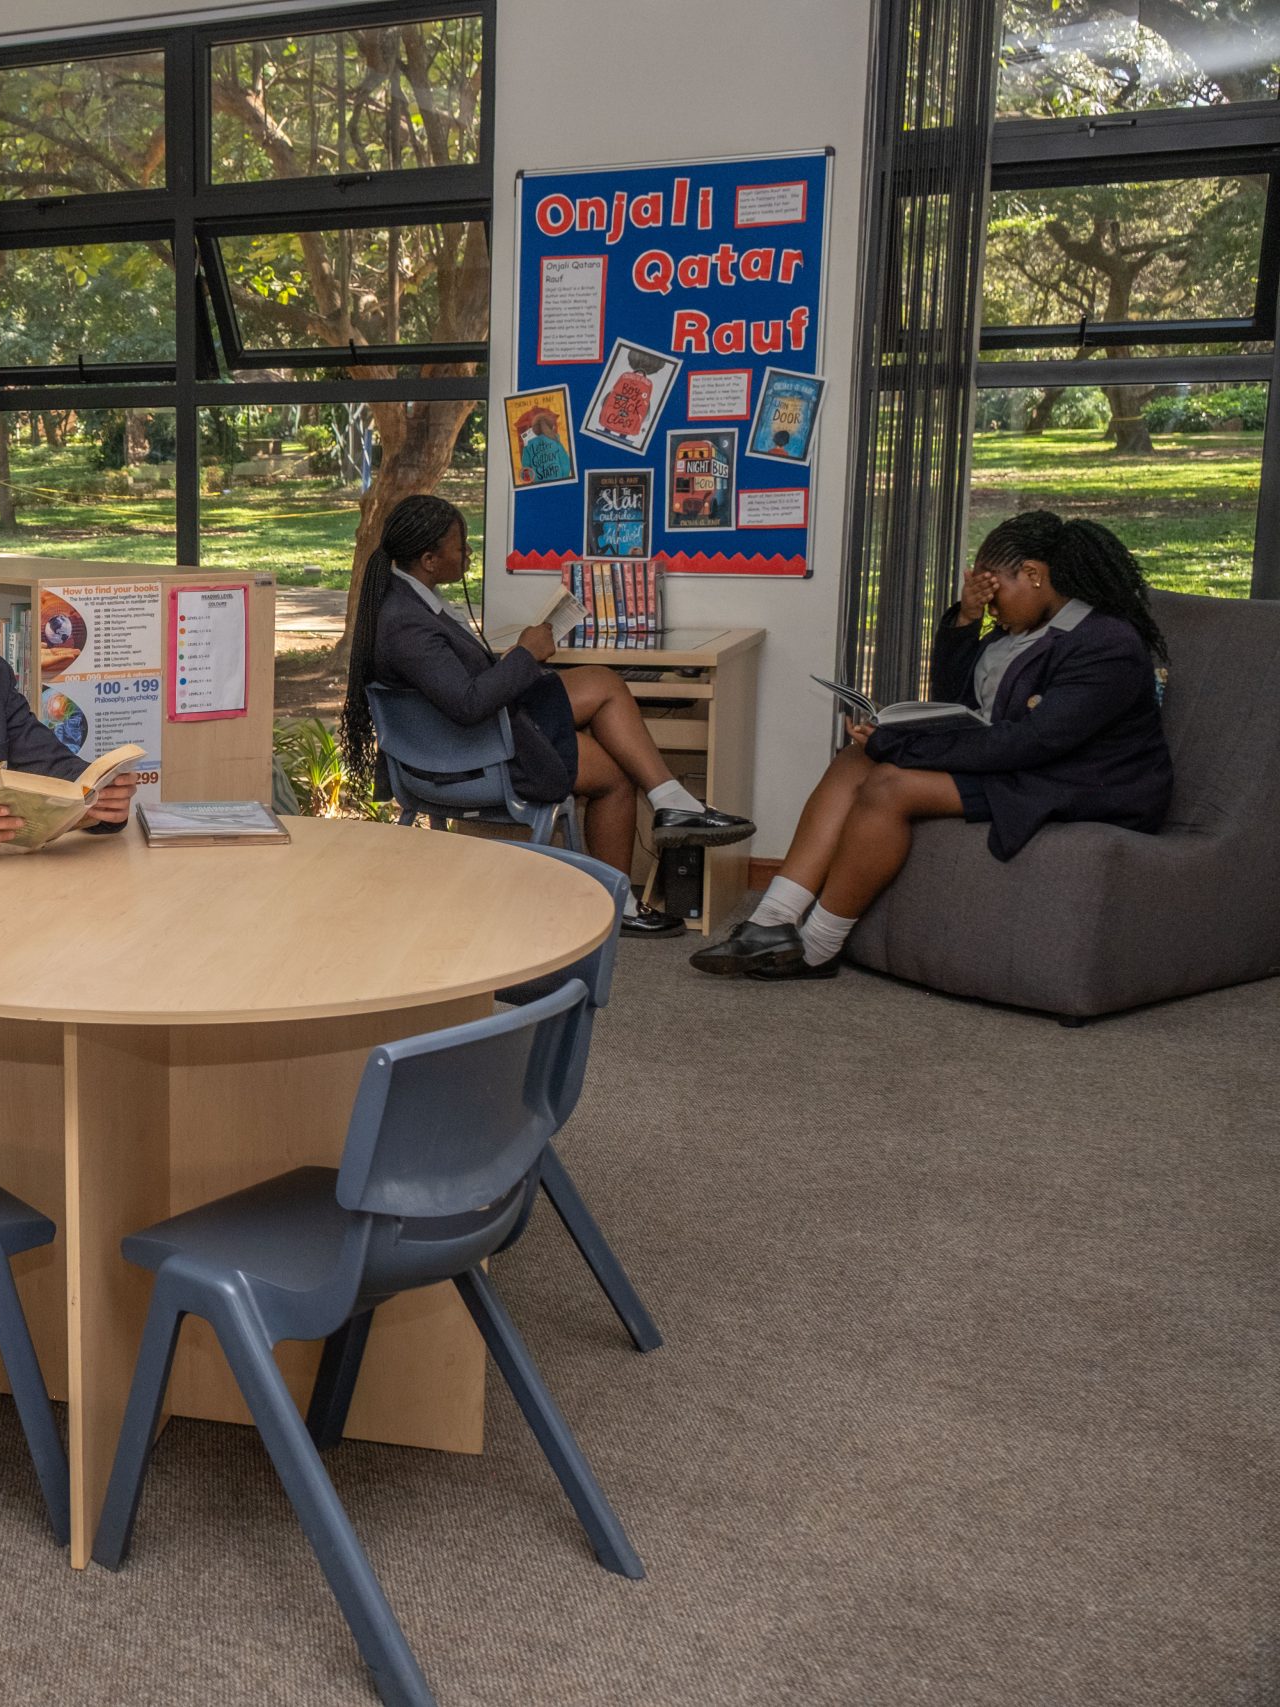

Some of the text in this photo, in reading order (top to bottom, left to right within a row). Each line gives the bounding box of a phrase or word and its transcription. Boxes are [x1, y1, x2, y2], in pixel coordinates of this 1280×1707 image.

[536, 178, 714, 245] Onjali
[546, 262, 569, 272] Onjali
[632, 244, 803, 295] Qatar
[545, 274, 563, 283] Rauf
[672, 306, 809, 354] Rauf
[773, 409, 801, 424] DOOR
[687, 460, 710, 473] NIGHT
[712, 462, 728, 477] BUS
[598, 488, 642, 511] Star
[63, 587, 81, 595] How
[95, 586, 112, 594] find
[113, 586, 132, 595] your
[133, 584, 159, 592] books
[95, 682, 120, 695] 100
[133, 679, 159, 692] 199
[127, 694, 159, 702] psychology
